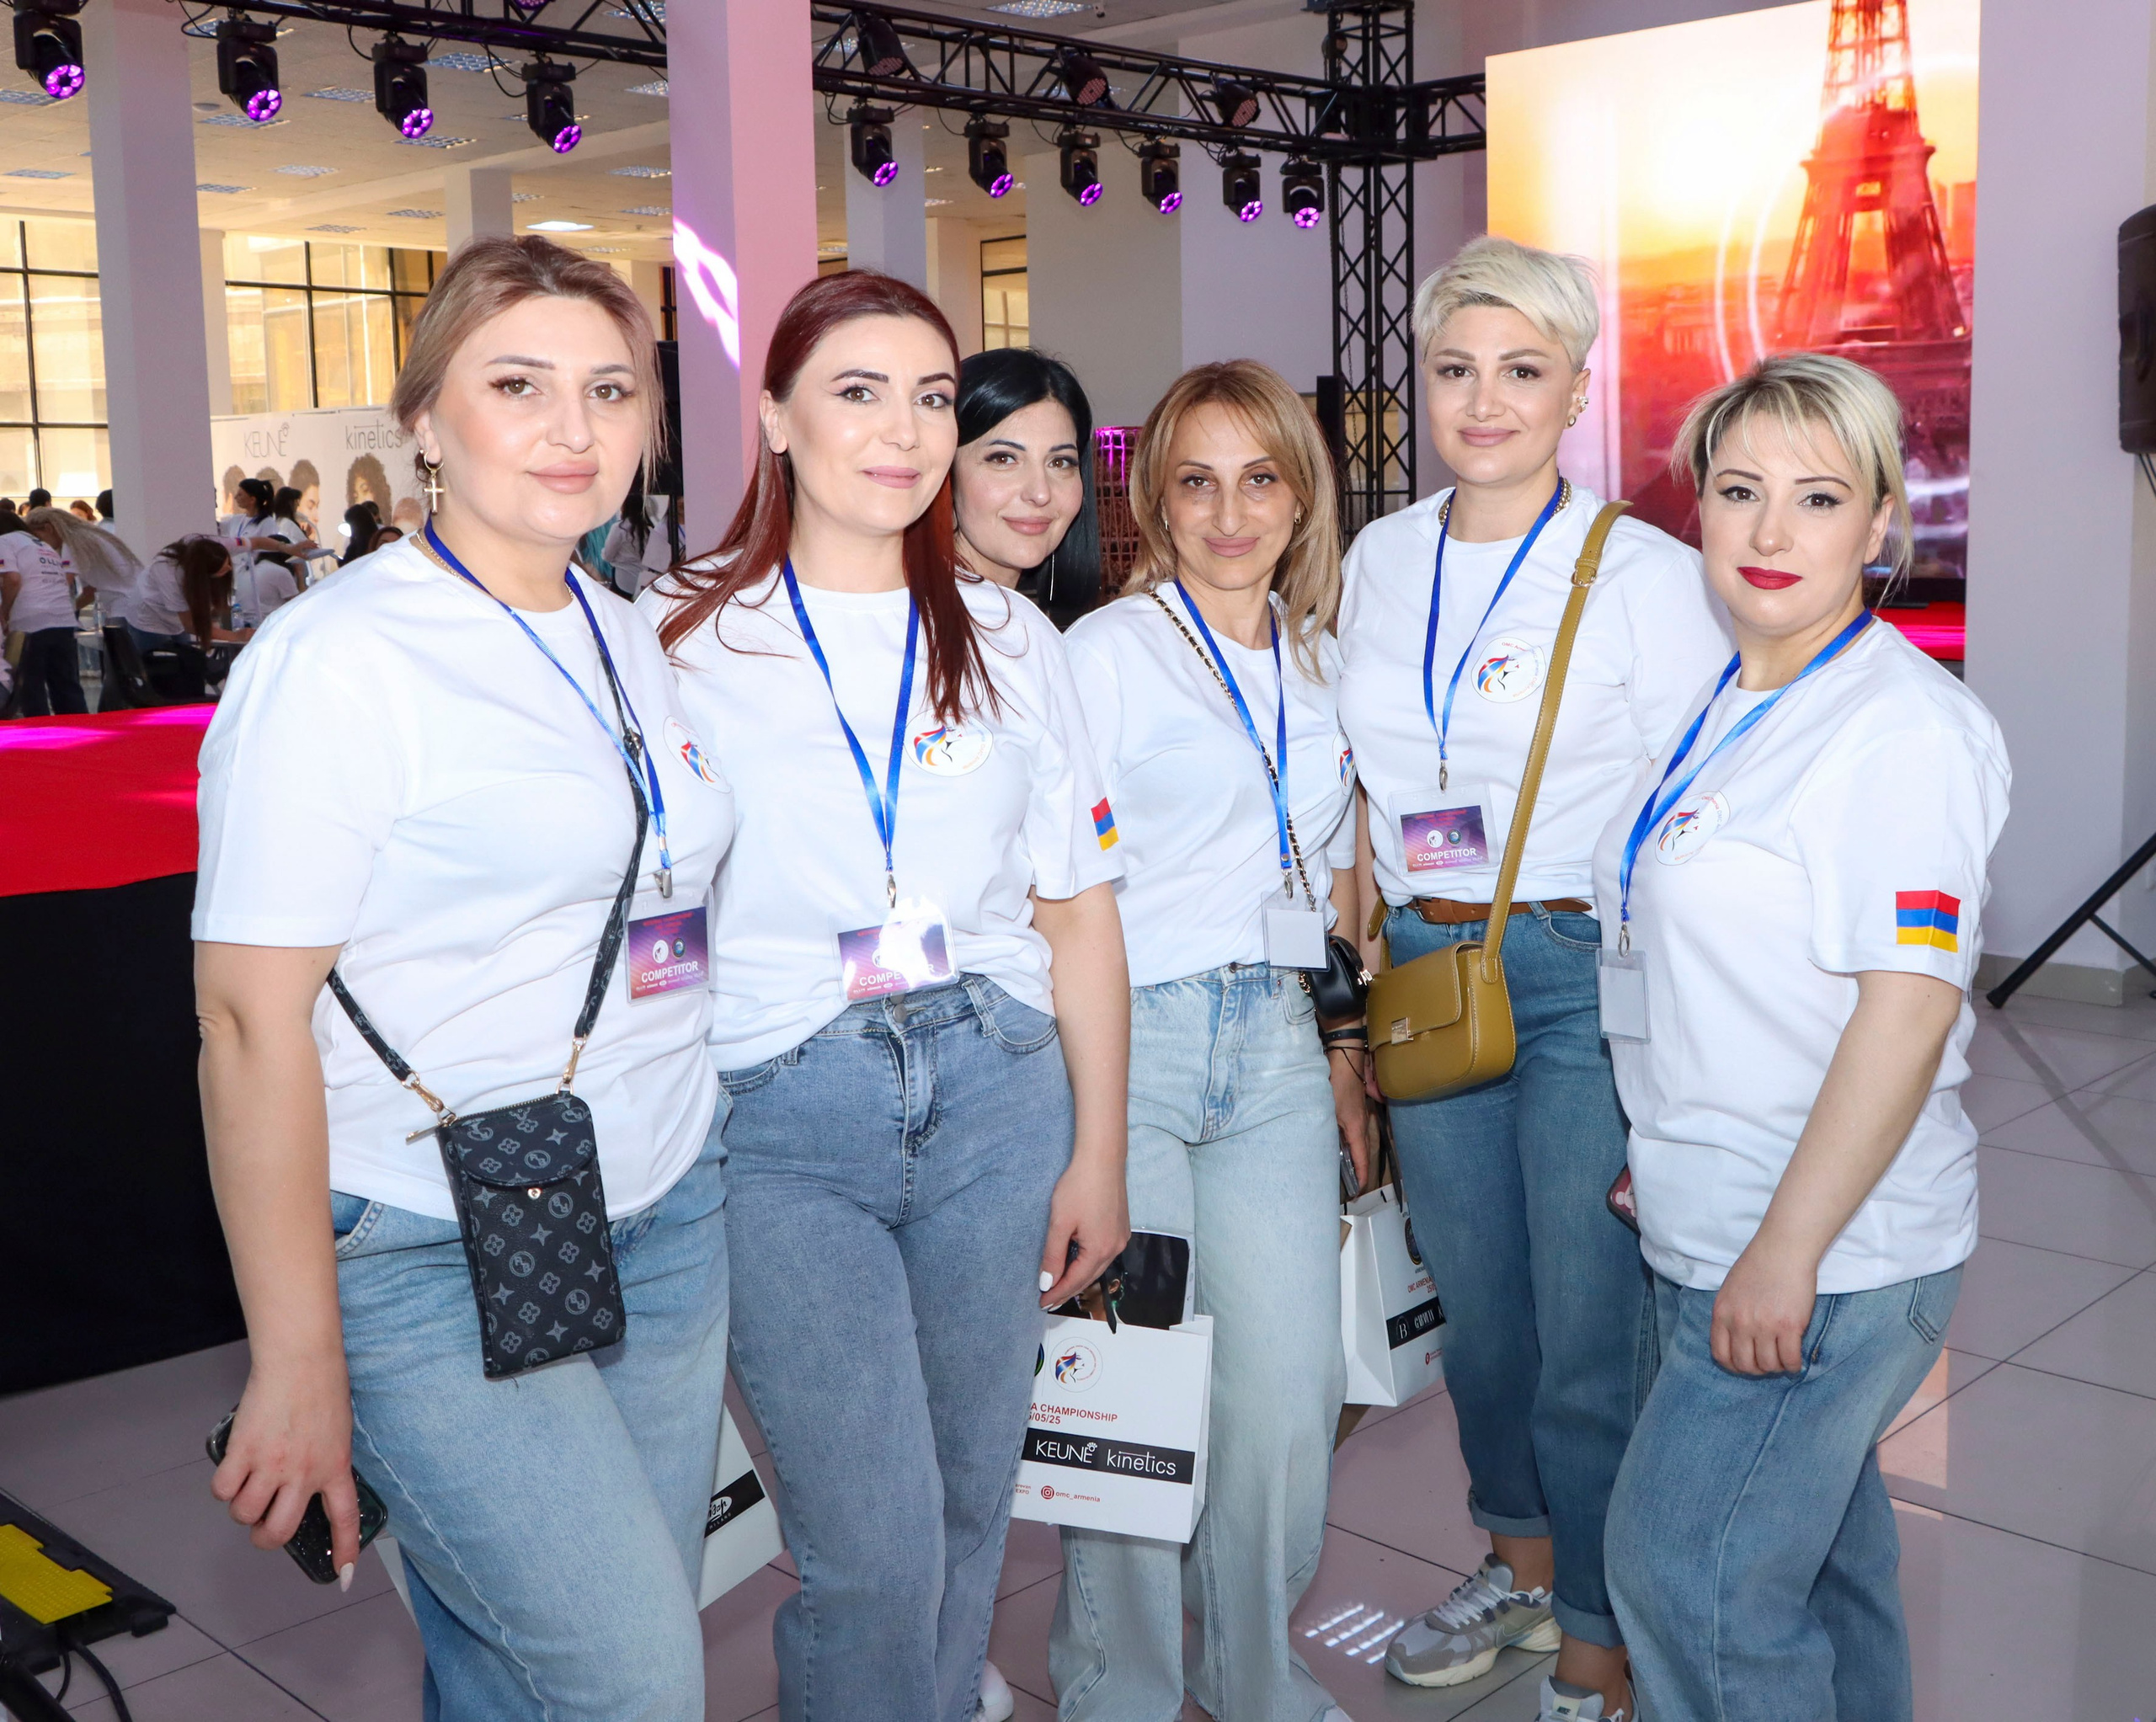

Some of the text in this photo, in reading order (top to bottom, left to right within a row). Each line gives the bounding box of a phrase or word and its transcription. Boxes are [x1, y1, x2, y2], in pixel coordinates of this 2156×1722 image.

[243, 419, 403, 457] KEUNE kinetics
[1417, 847, 1477, 862] COMPETITOR
[641, 960, 699, 984] COMPETITOR
[1040, 1403, 1118, 1422] CHAMPIONSHIP
[1035, 1439, 1177, 1476] KEUNE kinetics
[1055, 1490, 1101, 1502] omc_armenia
